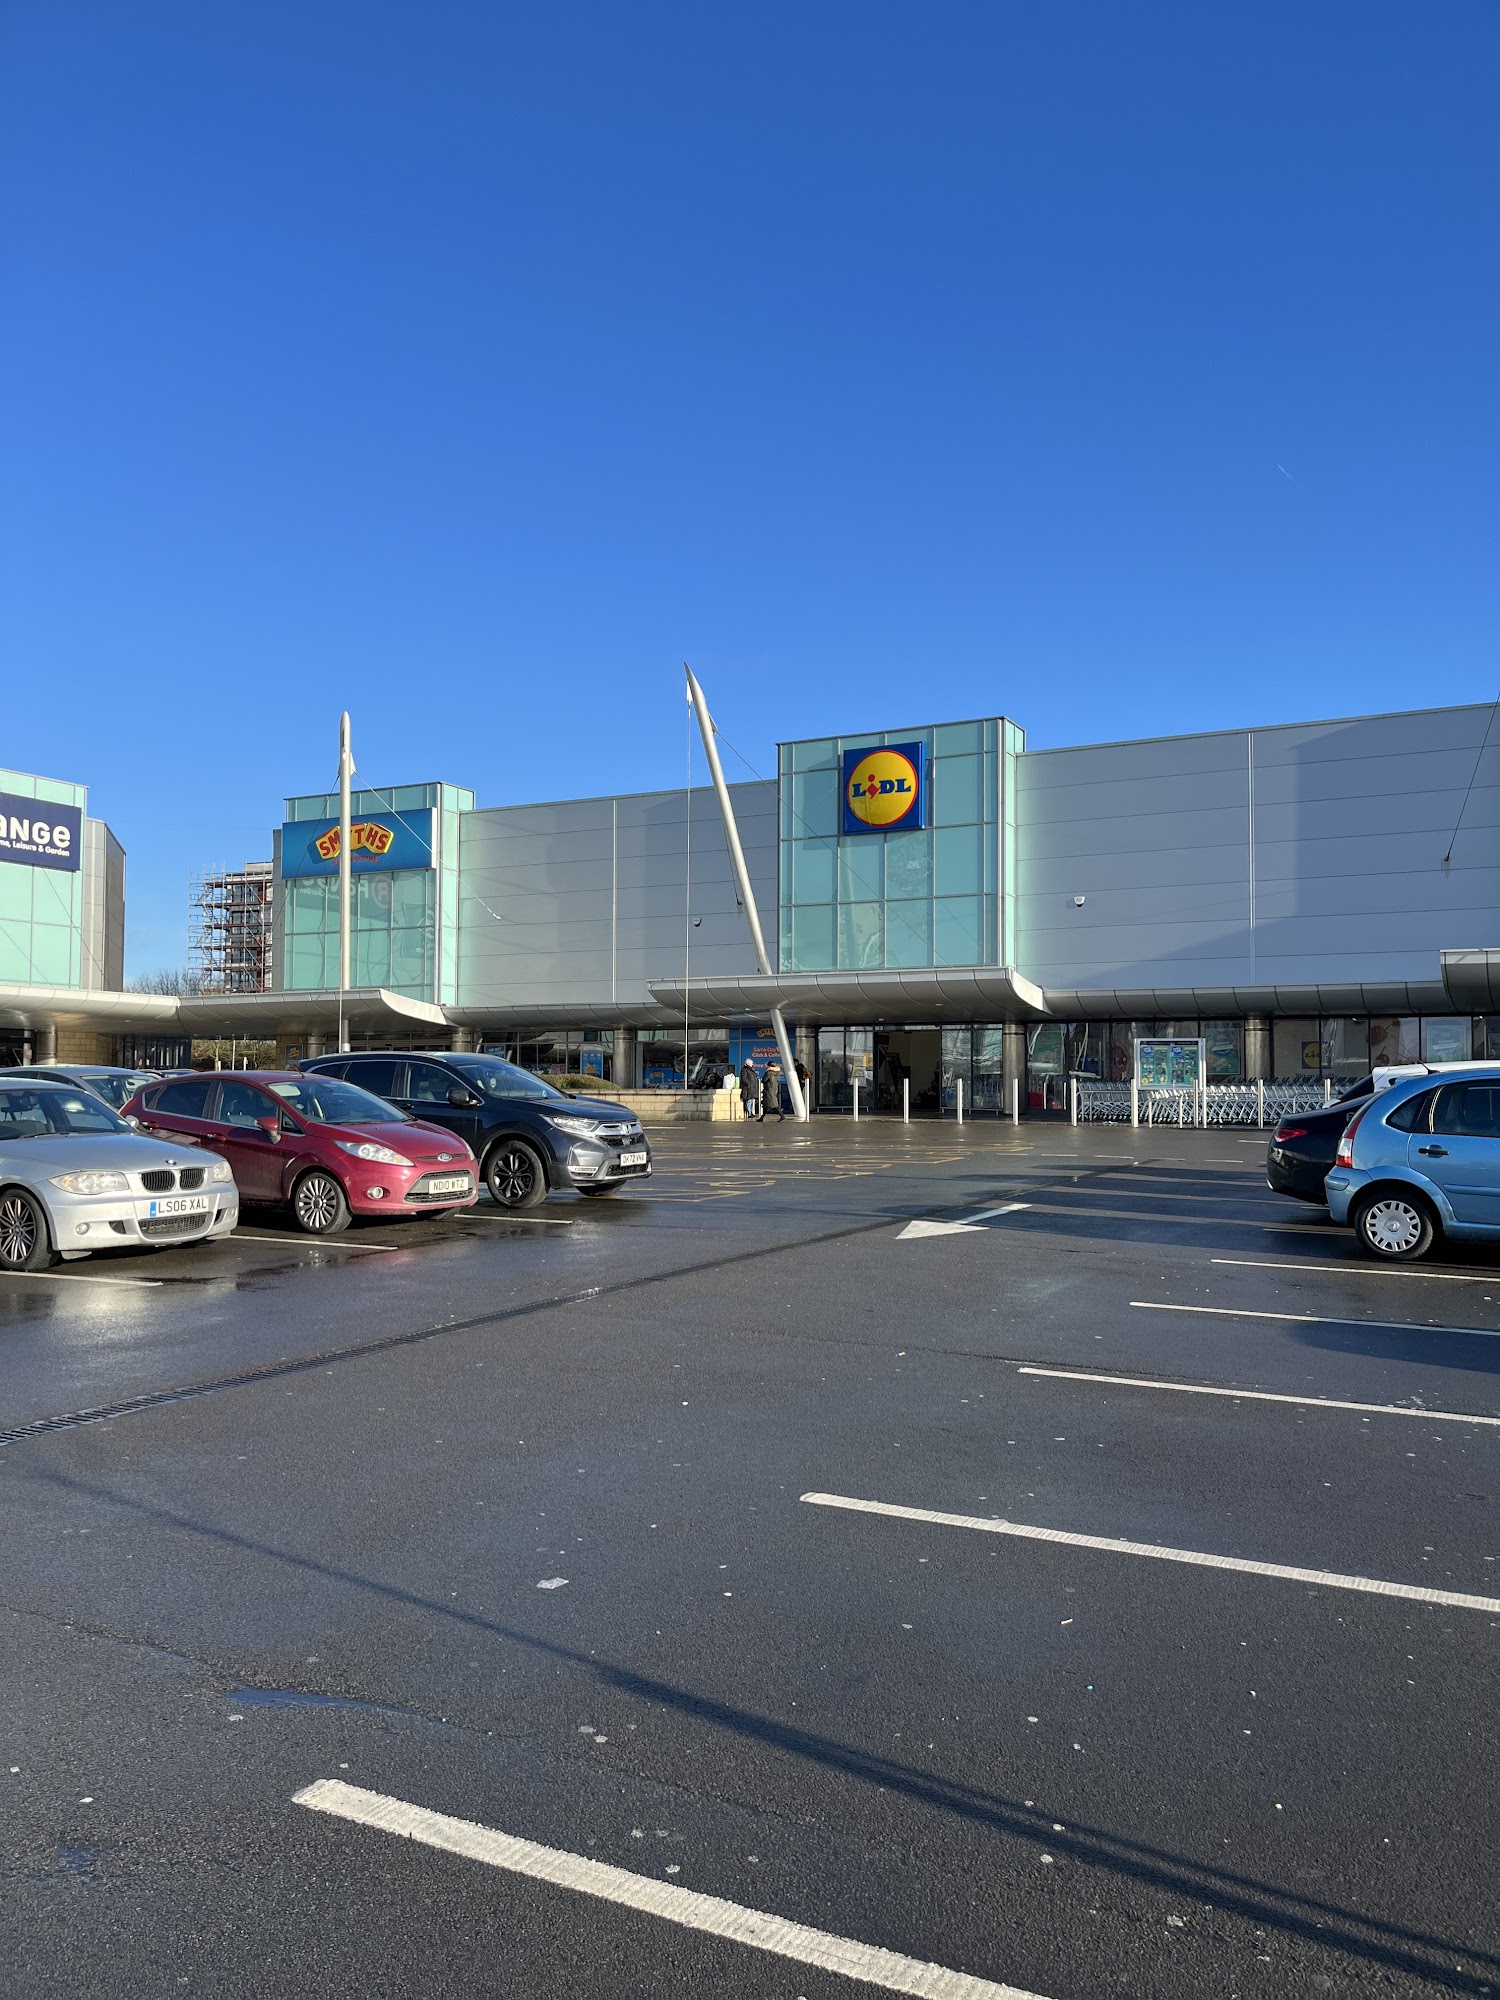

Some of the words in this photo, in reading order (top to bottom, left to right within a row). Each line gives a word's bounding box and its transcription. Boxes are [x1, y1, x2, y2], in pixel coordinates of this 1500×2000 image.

[13, 841, 37, 851] Leisure
[45, 846, 70, 857] Garden
[319, 828, 389, 856] SMTHS
[158, 1200, 187, 1213] LS06
[190, 1197, 207, 1210] XAL
